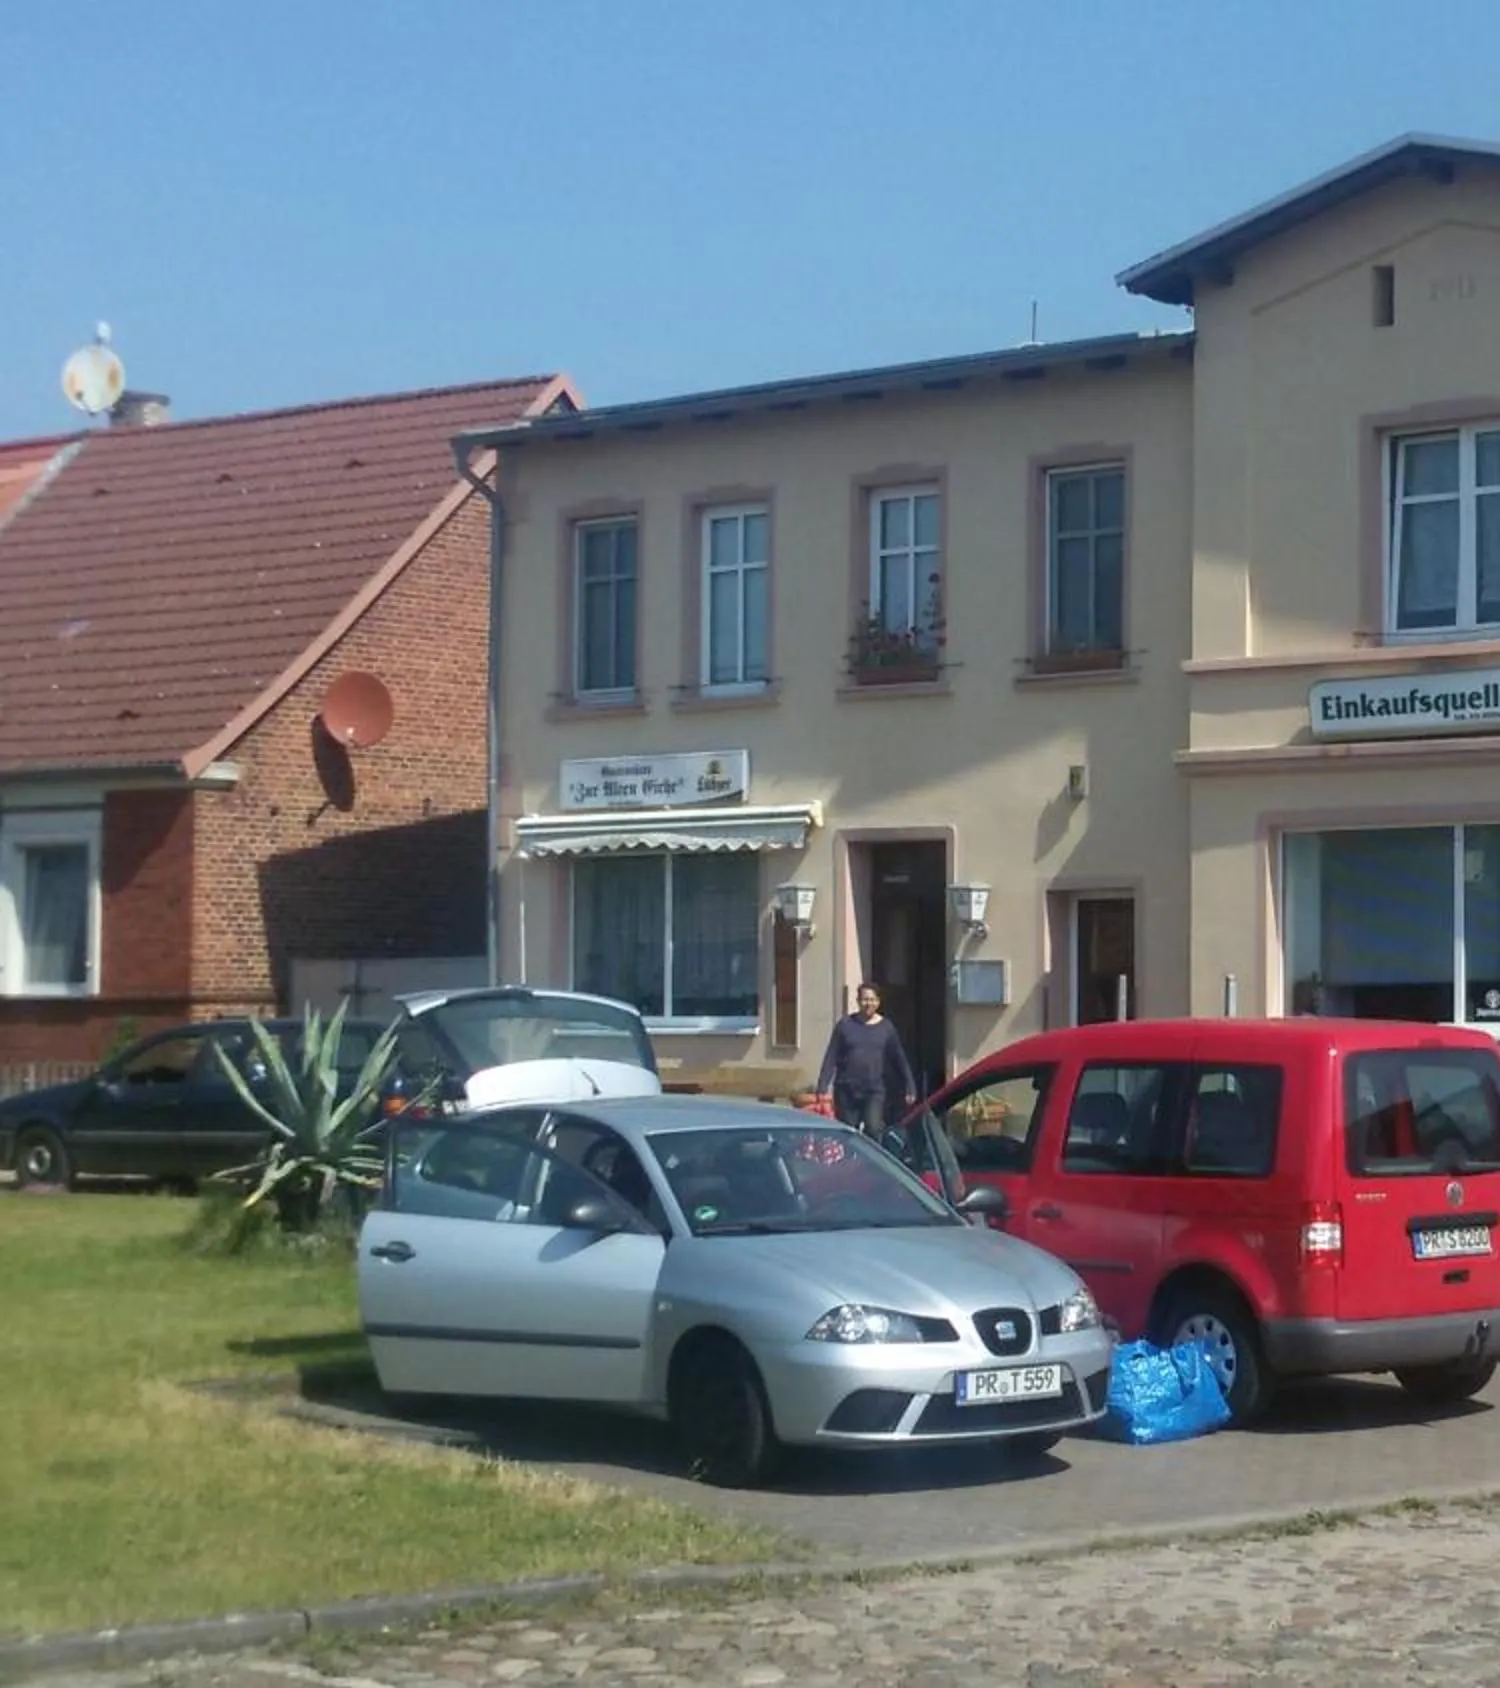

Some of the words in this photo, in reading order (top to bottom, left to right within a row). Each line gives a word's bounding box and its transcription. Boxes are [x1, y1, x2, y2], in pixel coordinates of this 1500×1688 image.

[975, 1374, 998, 1395] PR
[1010, 1372, 1022, 1393] T
[1023, 1369, 1055, 1391] 559
